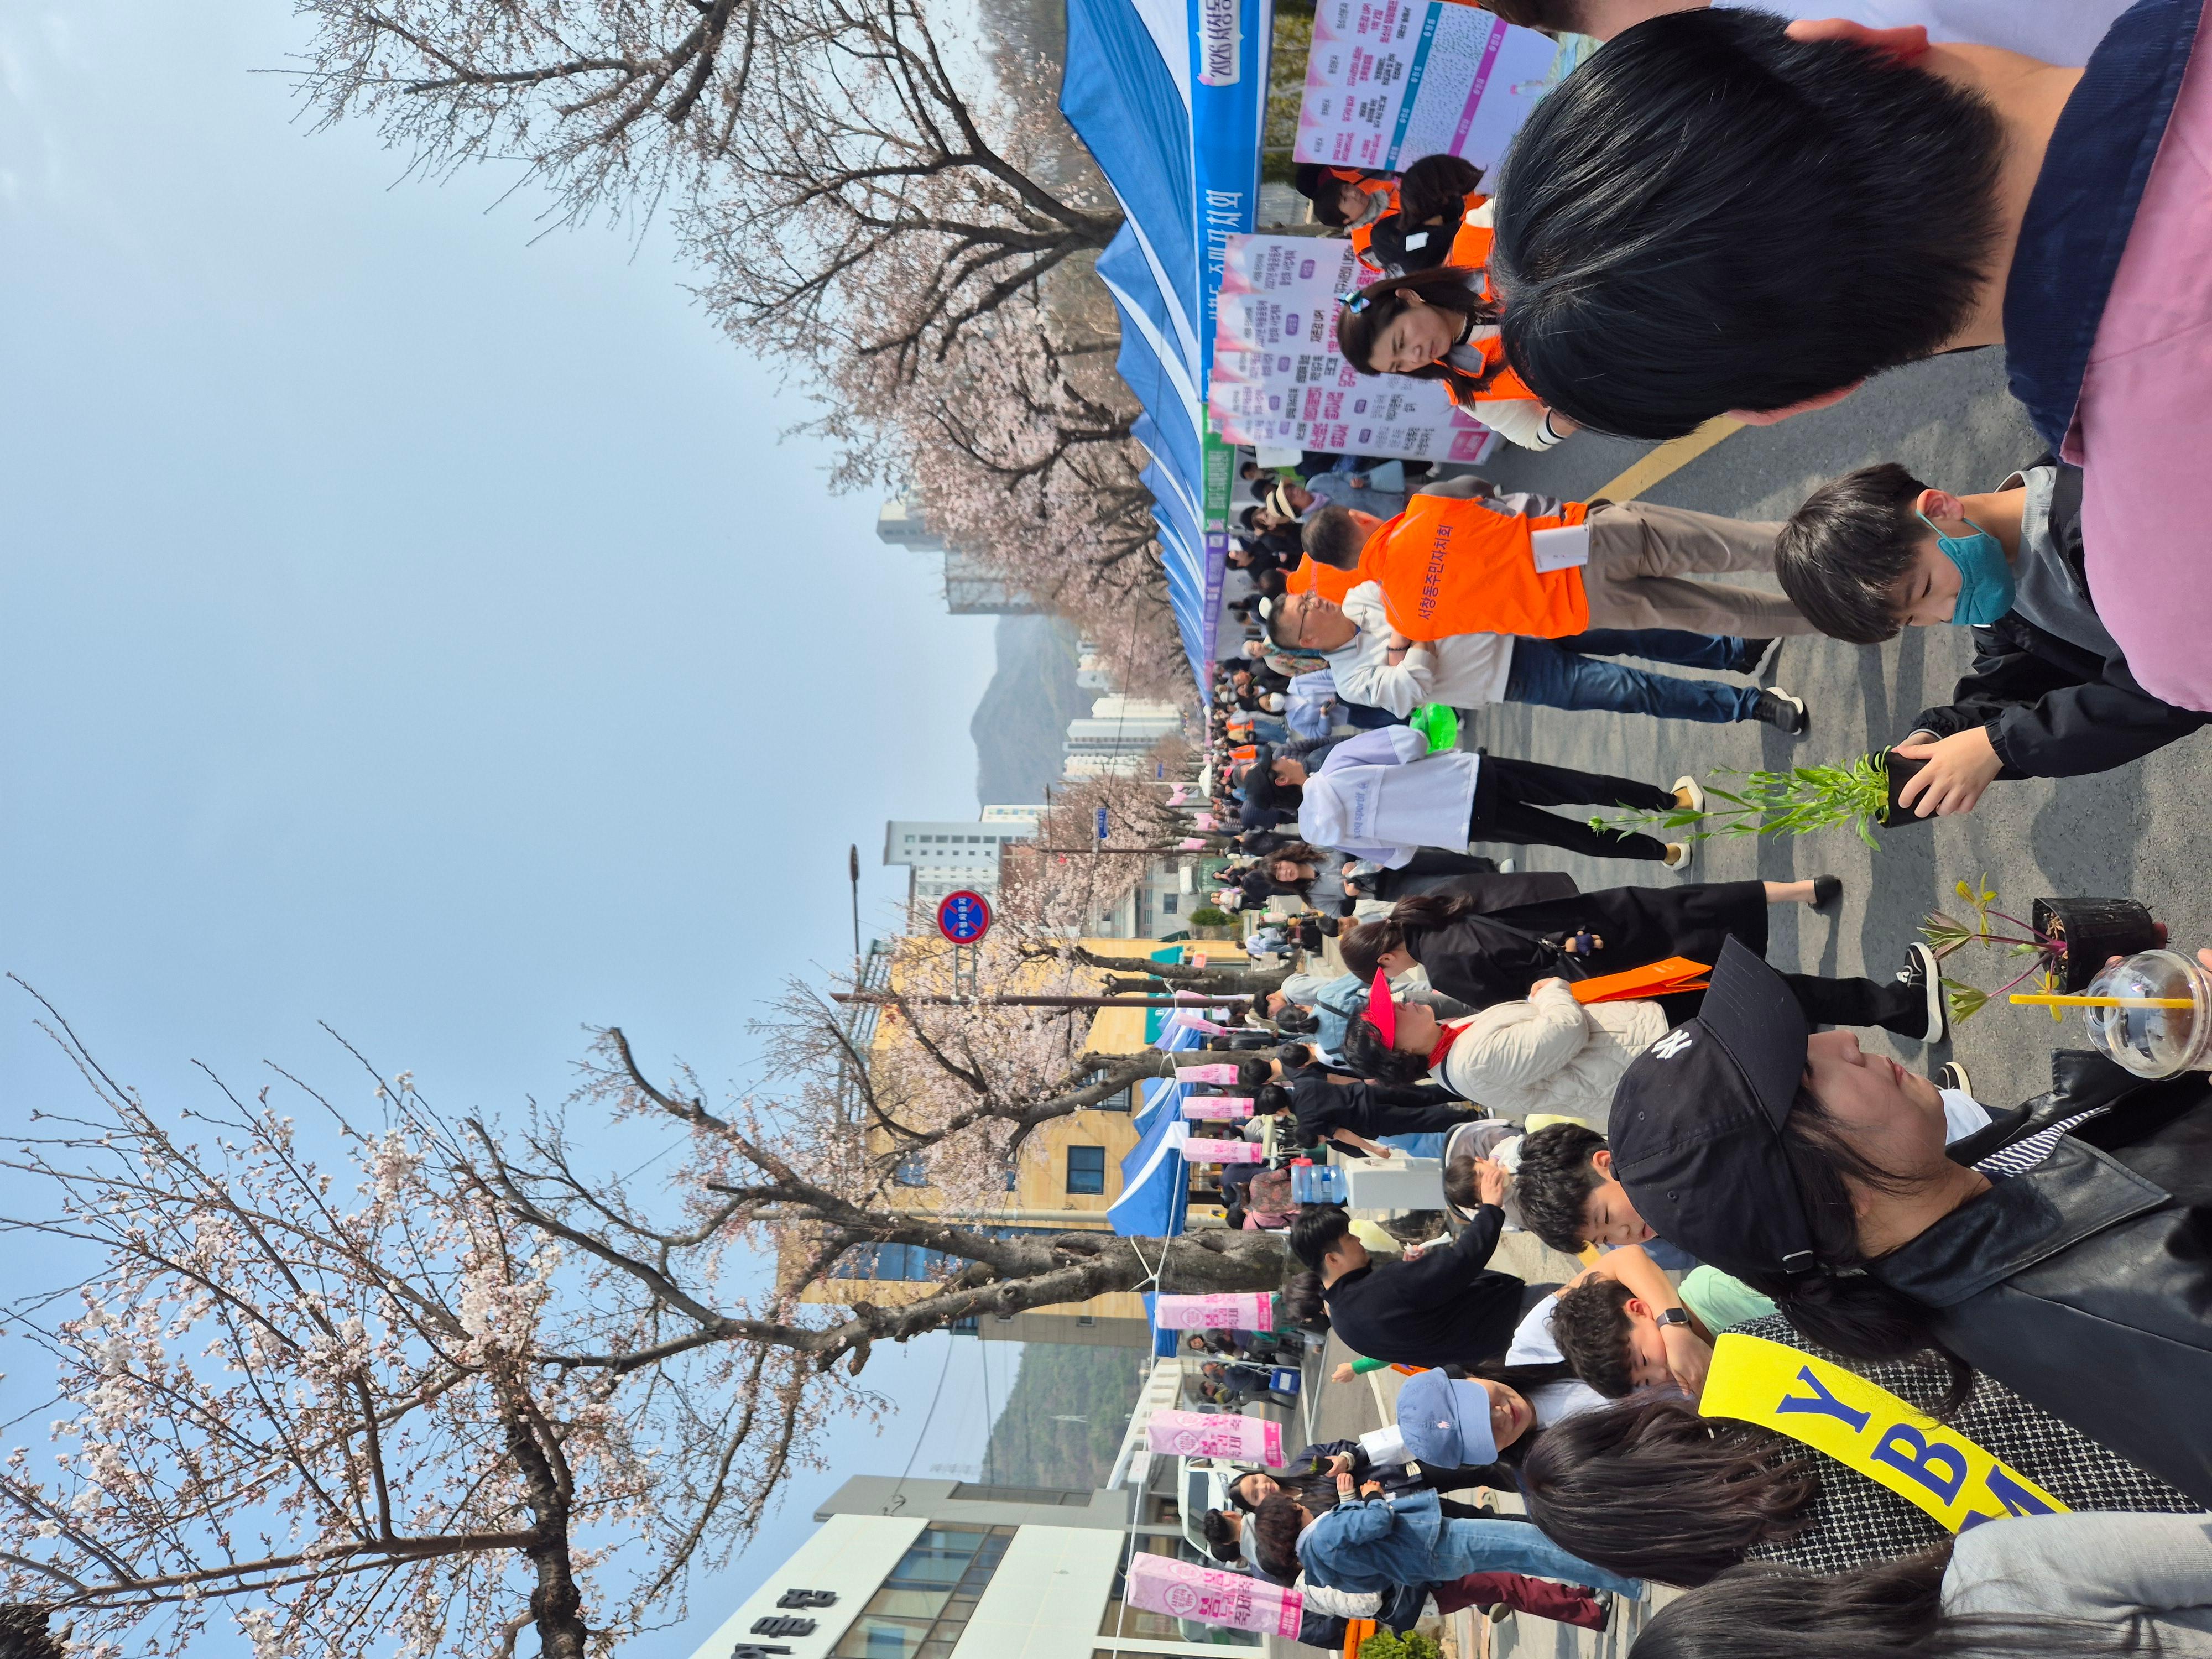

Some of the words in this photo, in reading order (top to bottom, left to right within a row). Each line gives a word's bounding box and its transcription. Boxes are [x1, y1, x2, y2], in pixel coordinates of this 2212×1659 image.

[1206, 0, 1233, 39] 서창동
[1357, 15, 1370, 34] 자존감
[1208, 43, 1232, 77] 2026
[1310, 322, 1323, 342] 자존감
[1417, 524, 1453, 620] 서창동주민자치회
[1354, 792, 1365, 821] sportif
[1651, 1029, 1692, 1060] NY
